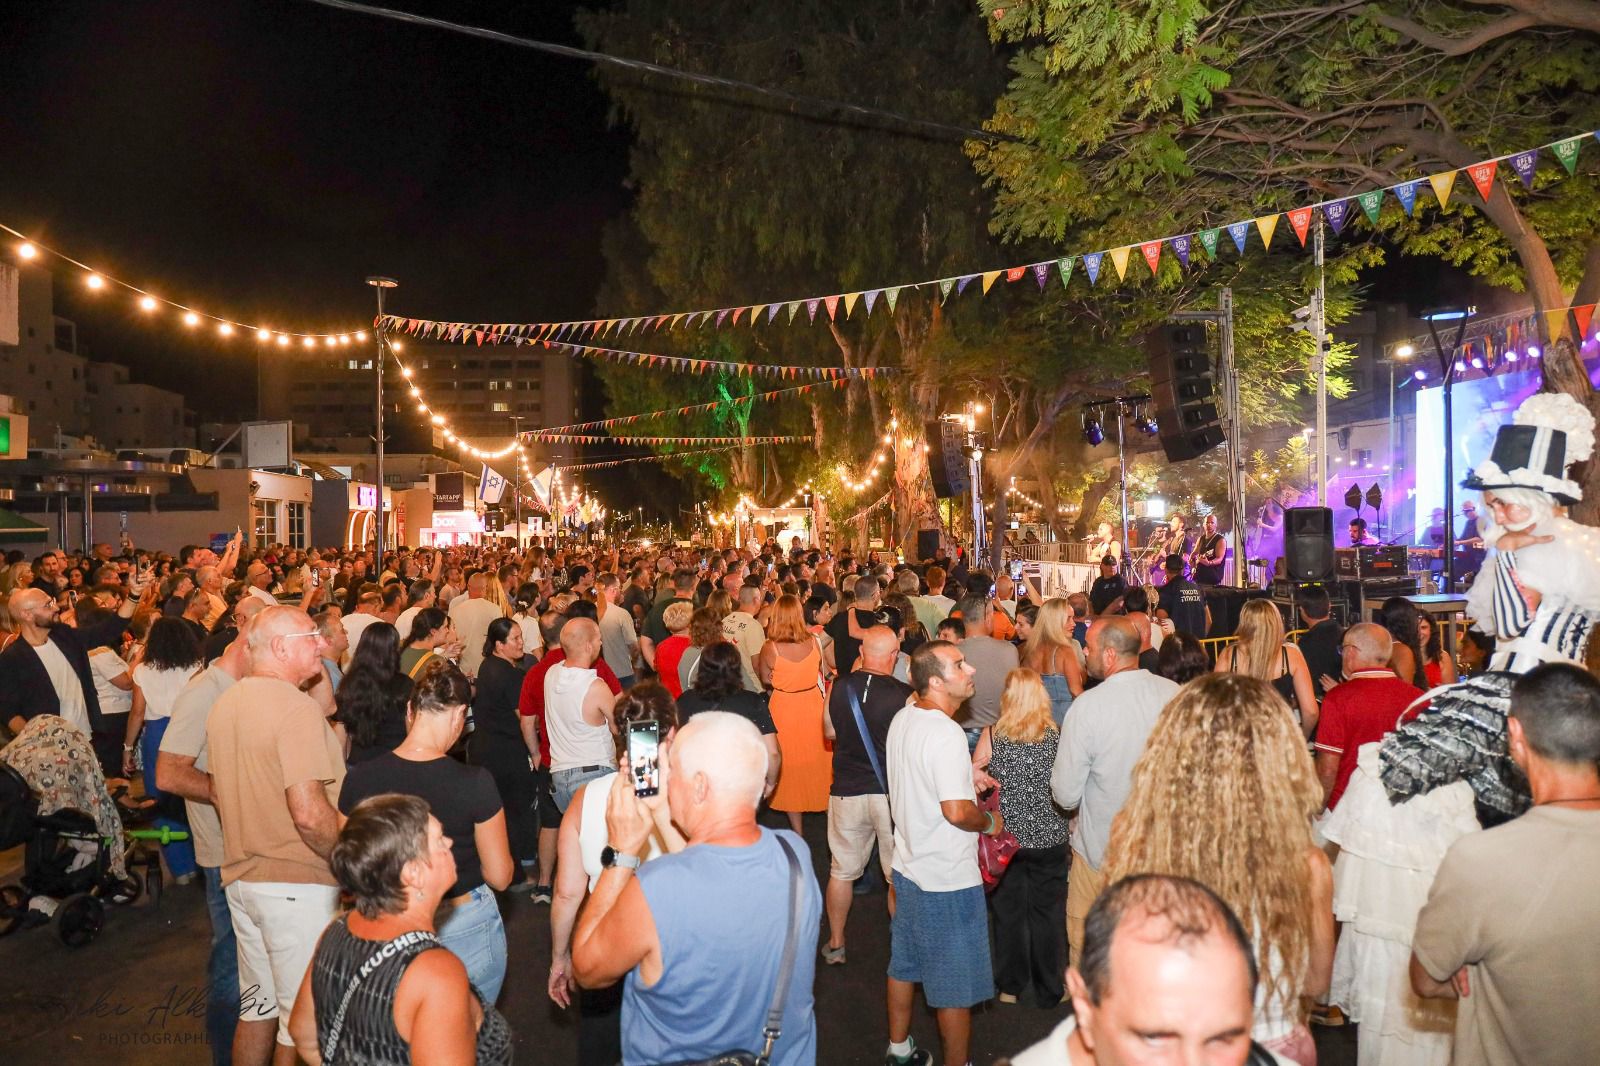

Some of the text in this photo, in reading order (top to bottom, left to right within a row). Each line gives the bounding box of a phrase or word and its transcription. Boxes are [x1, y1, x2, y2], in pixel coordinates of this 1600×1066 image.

[1559, 141, 1576, 154] OPEN
[1516, 155, 1532, 167] OPEN
[1475, 168, 1490, 180] OPEN
[1328, 205, 1342, 215] OPEN
[324, 1028, 340, 1062] 1980
